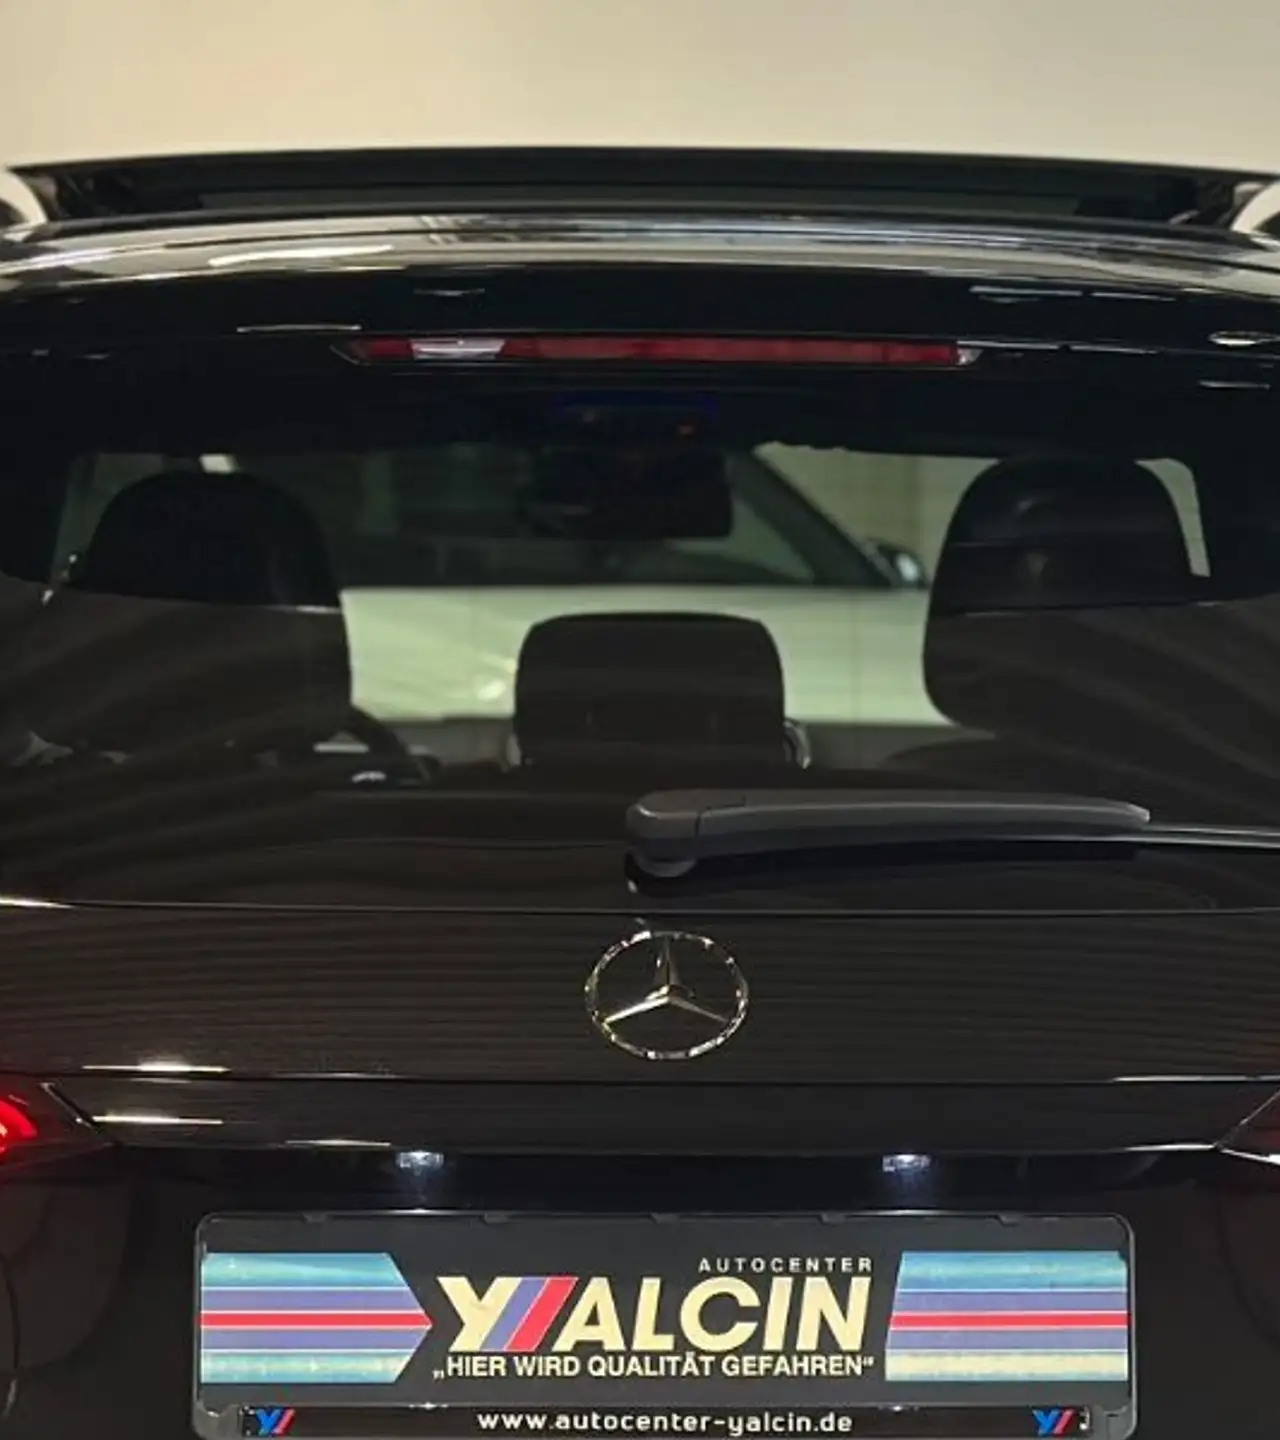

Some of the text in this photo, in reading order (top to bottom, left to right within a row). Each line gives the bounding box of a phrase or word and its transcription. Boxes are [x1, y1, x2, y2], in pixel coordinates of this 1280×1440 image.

[698, 1257, 872, 1273] AUTOCENTER
[512, 1355, 581, 1377] WIRD
[587, 1349, 717, 1378] QUALITÄT
[477, 1411, 853, 1437] www.autocenter-yalcin.de
